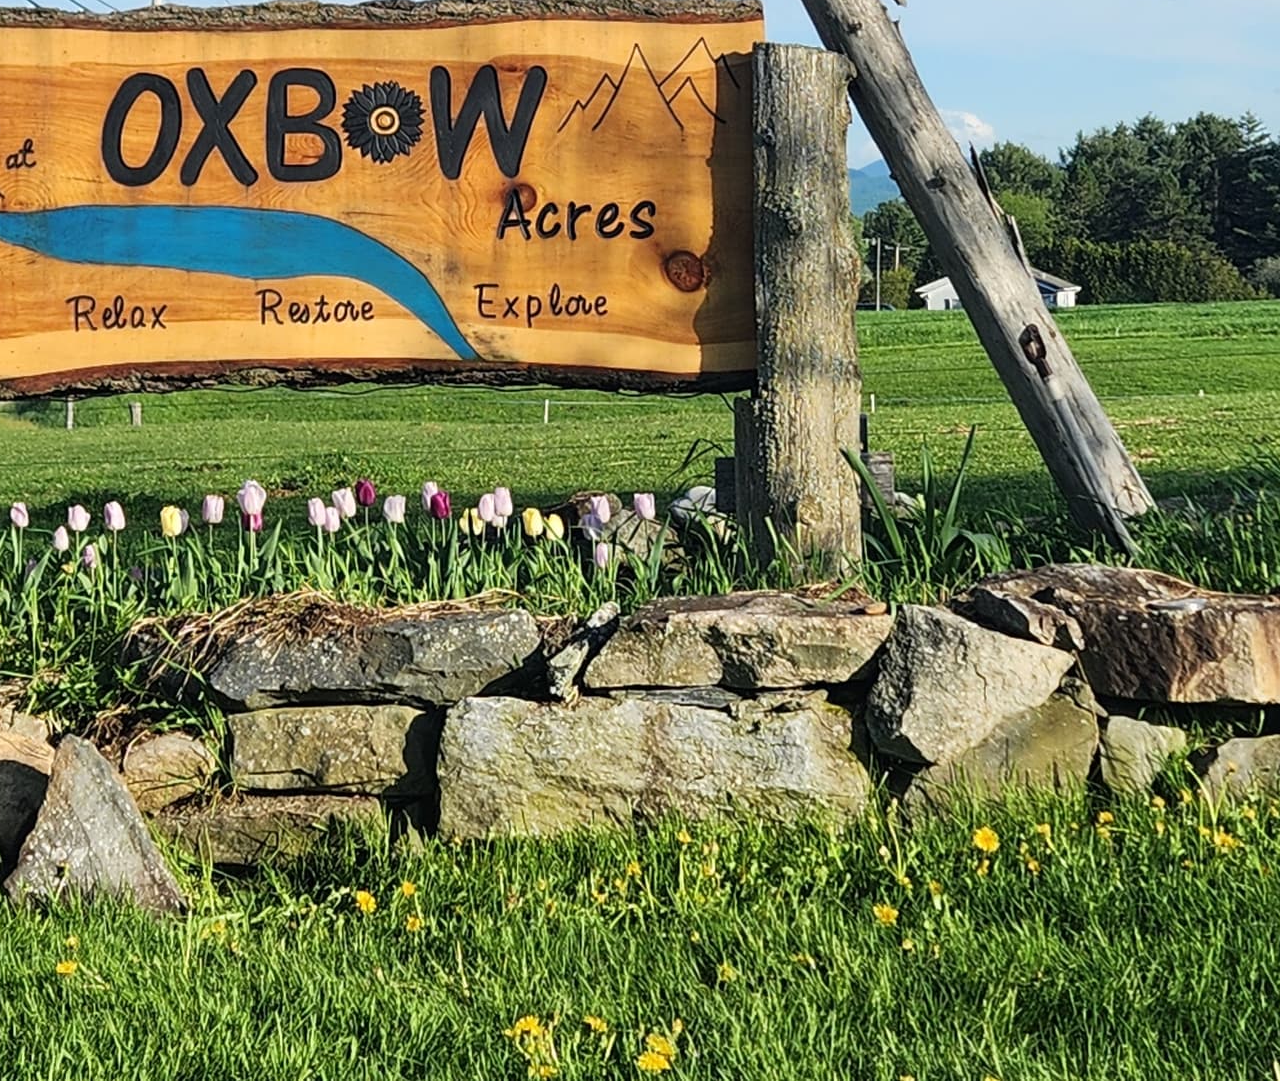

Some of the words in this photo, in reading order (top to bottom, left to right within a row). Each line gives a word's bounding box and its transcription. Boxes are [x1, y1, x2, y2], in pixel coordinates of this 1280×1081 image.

[5, 138, 37, 170] at
[497, 197, 657, 241] Acres
[67, 295, 167, 331] Relax
[256, 289, 375, 325] Restore
[474, 284, 608, 324] Explore
